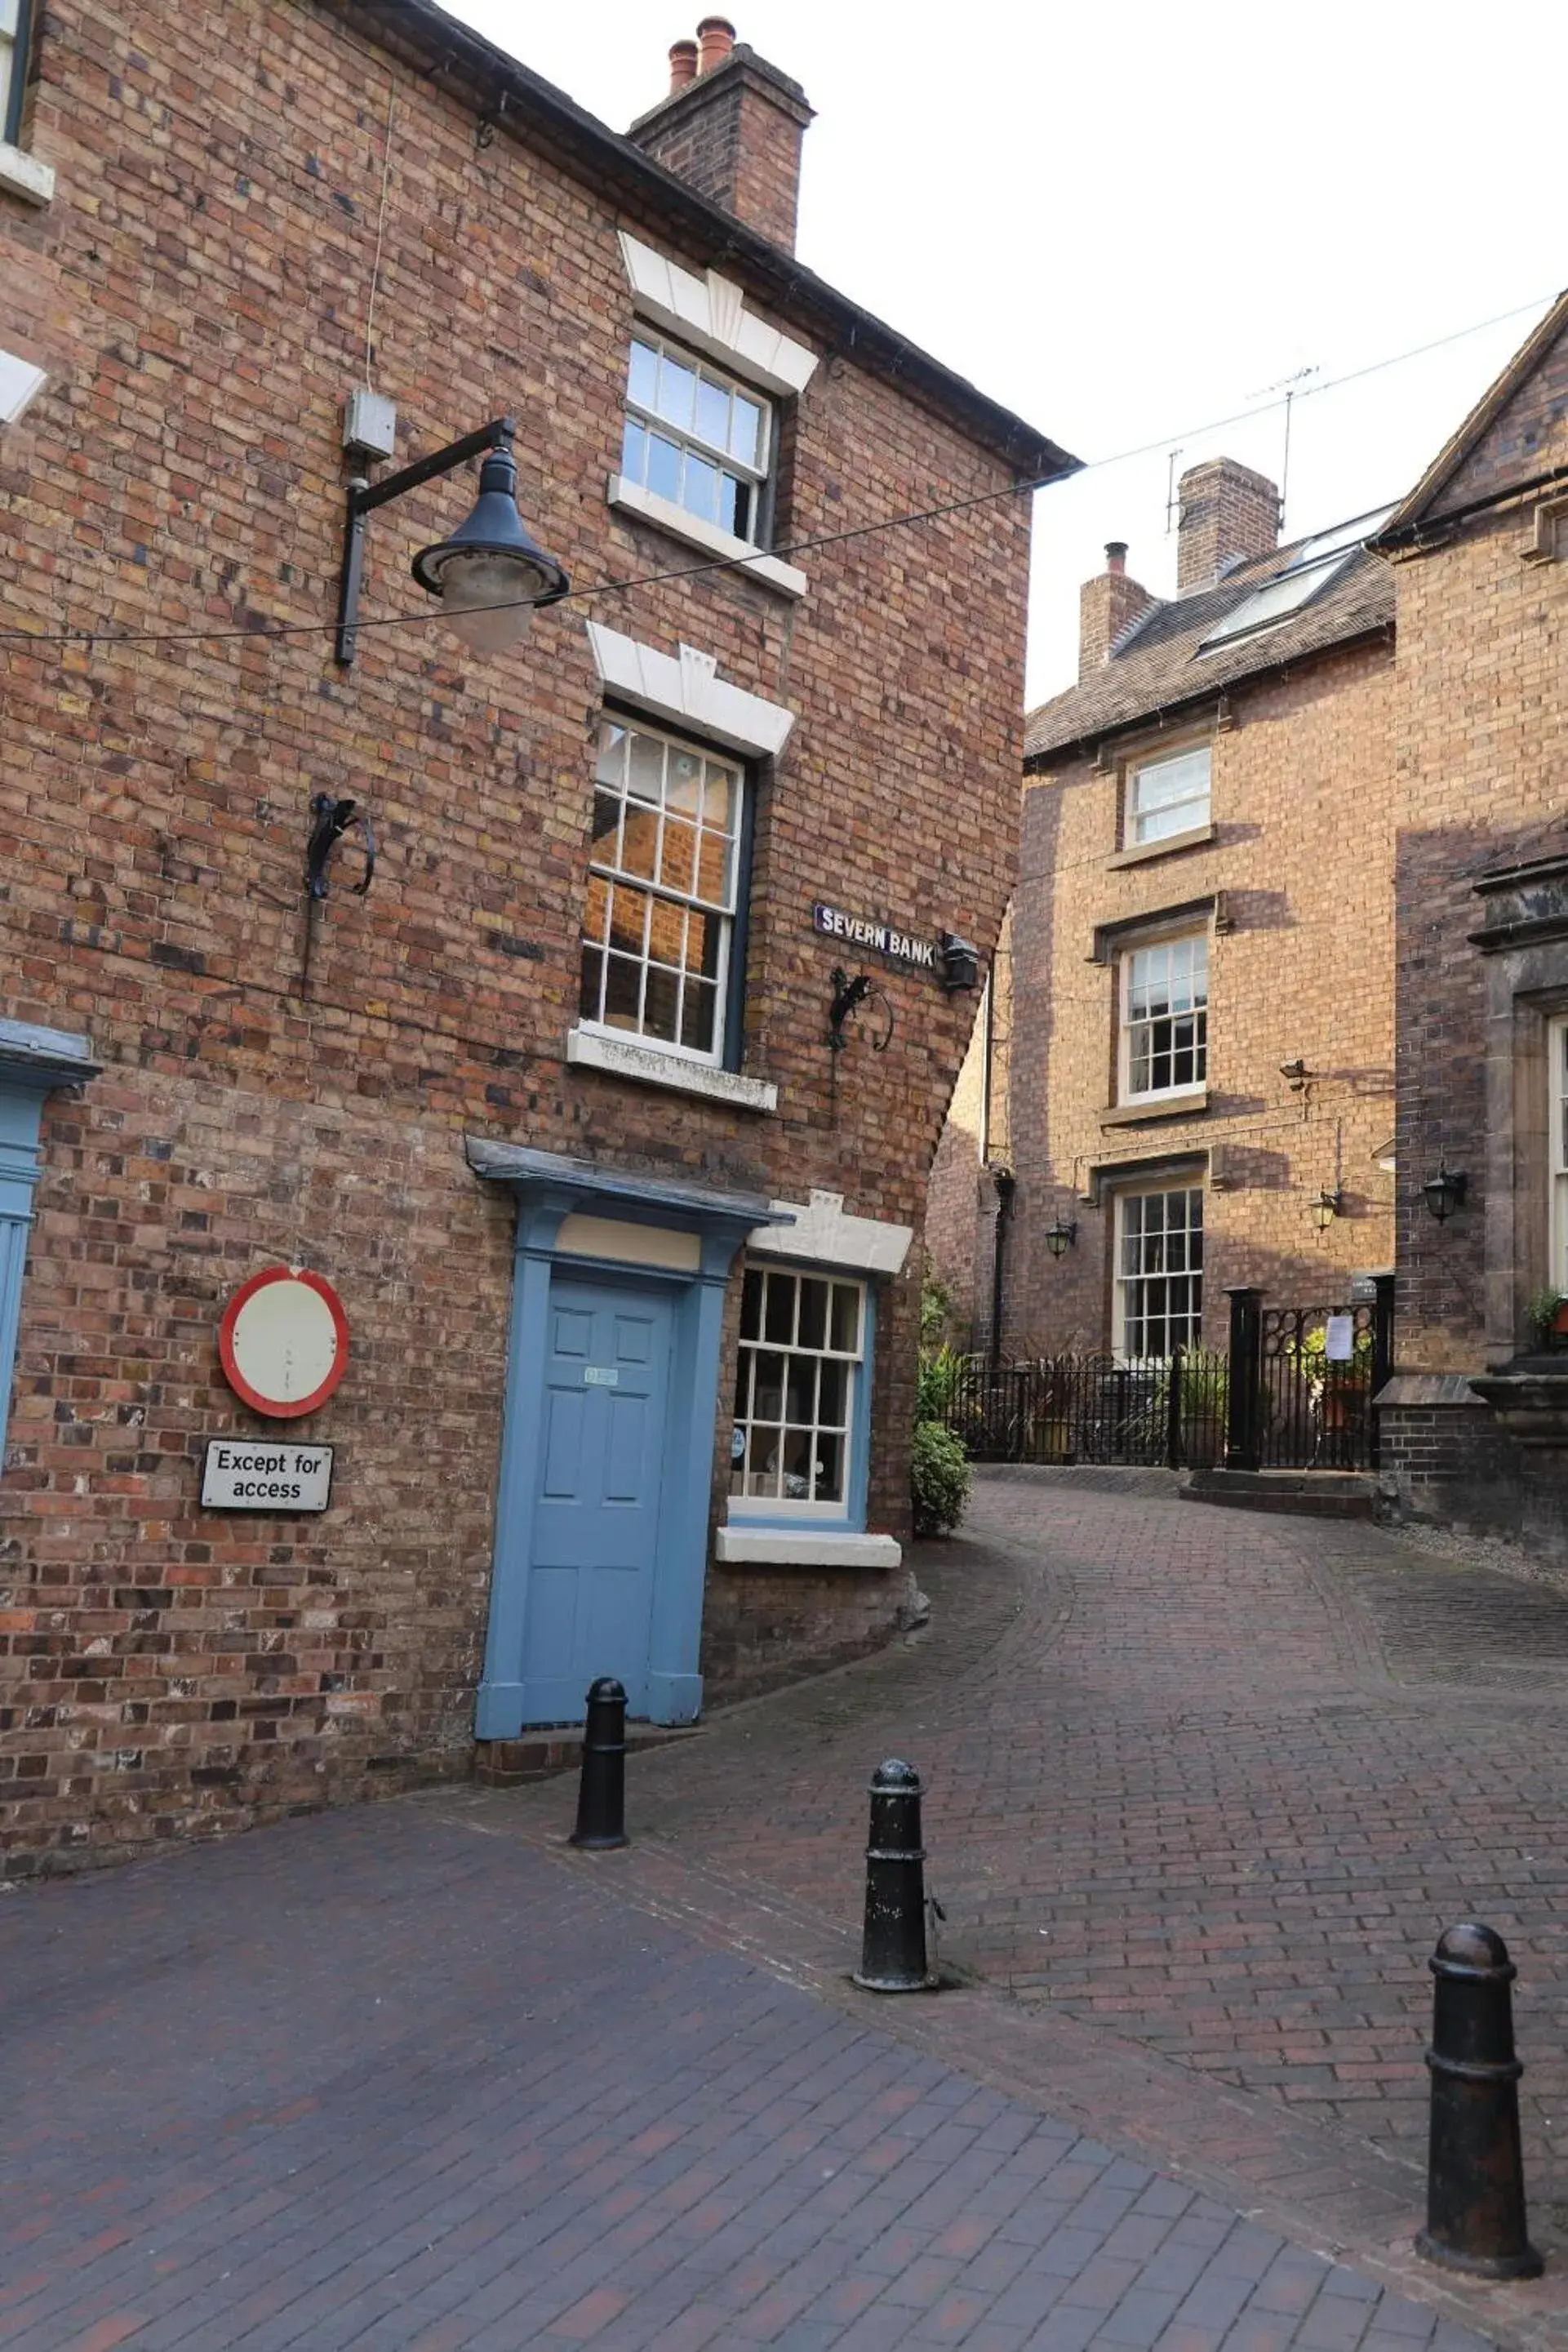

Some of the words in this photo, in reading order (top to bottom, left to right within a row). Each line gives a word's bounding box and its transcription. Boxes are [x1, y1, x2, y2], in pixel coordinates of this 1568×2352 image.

[822, 908, 886, 949] SEVERN
[890, 932, 933, 967] BANK
[217, 1450, 287, 1475] Except
[295, 1455, 322, 1474] for
[233, 1482, 301, 1498] access
